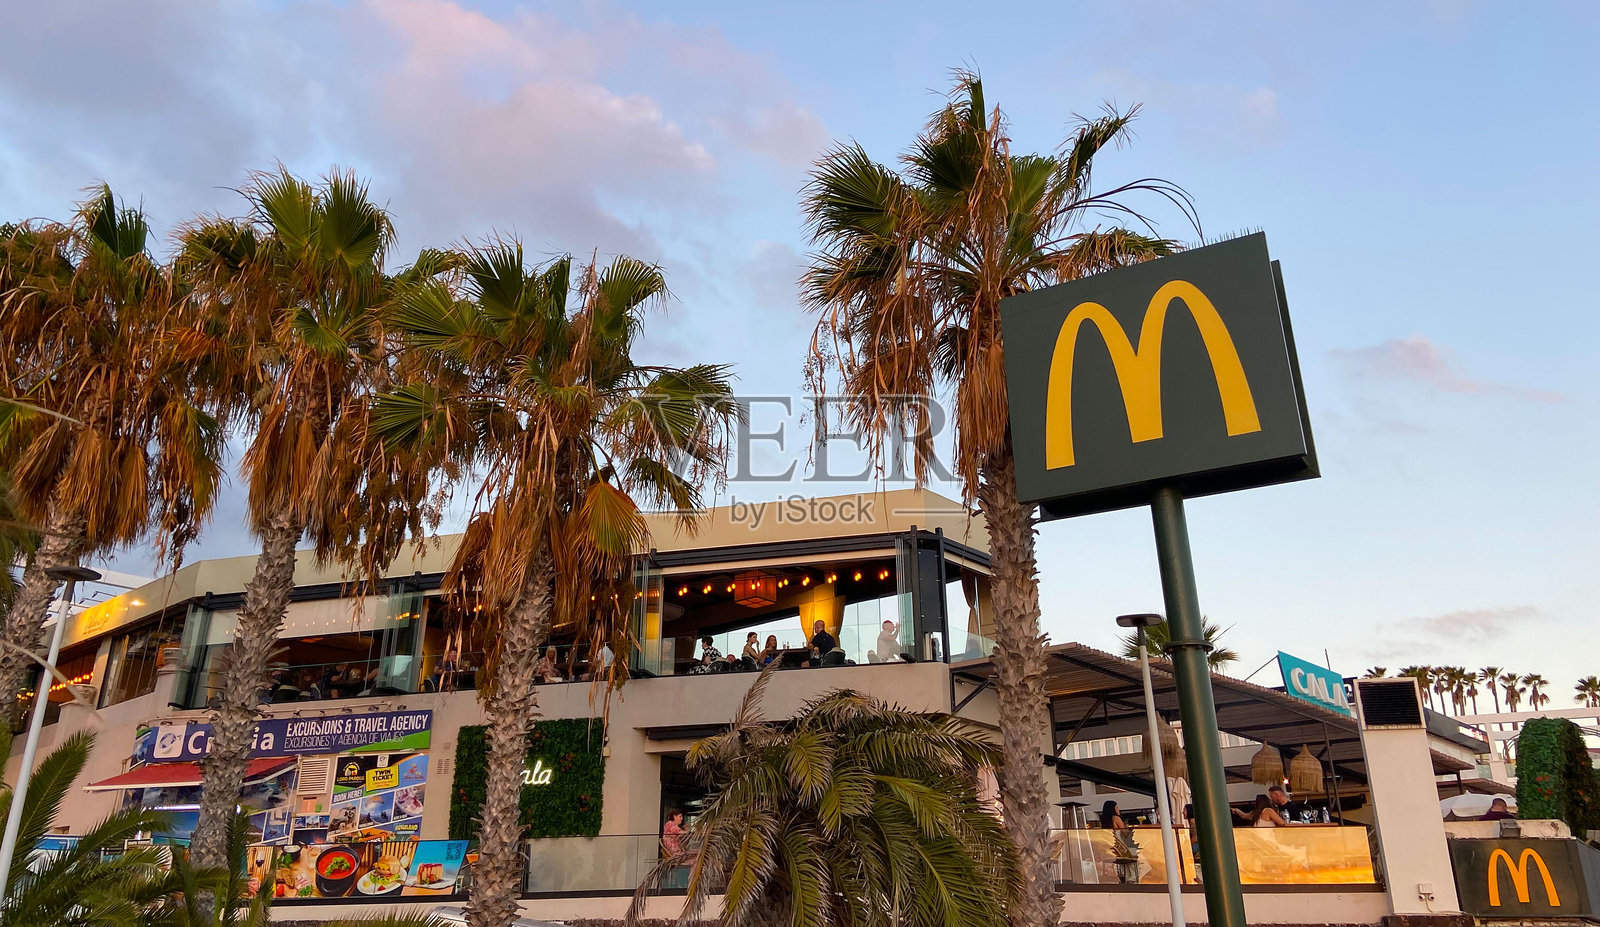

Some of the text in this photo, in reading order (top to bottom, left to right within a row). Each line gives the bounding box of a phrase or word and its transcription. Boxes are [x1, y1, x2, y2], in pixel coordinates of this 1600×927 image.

[1291, 667, 1350, 710] CALA
[286, 714, 429, 737] EXCURSIONS & TRAVEL AGENCY
[284, 731, 405, 749] EXCURSIONES Y AGENCIA DE VIAJES
[519, 759, 553, 785] ala
